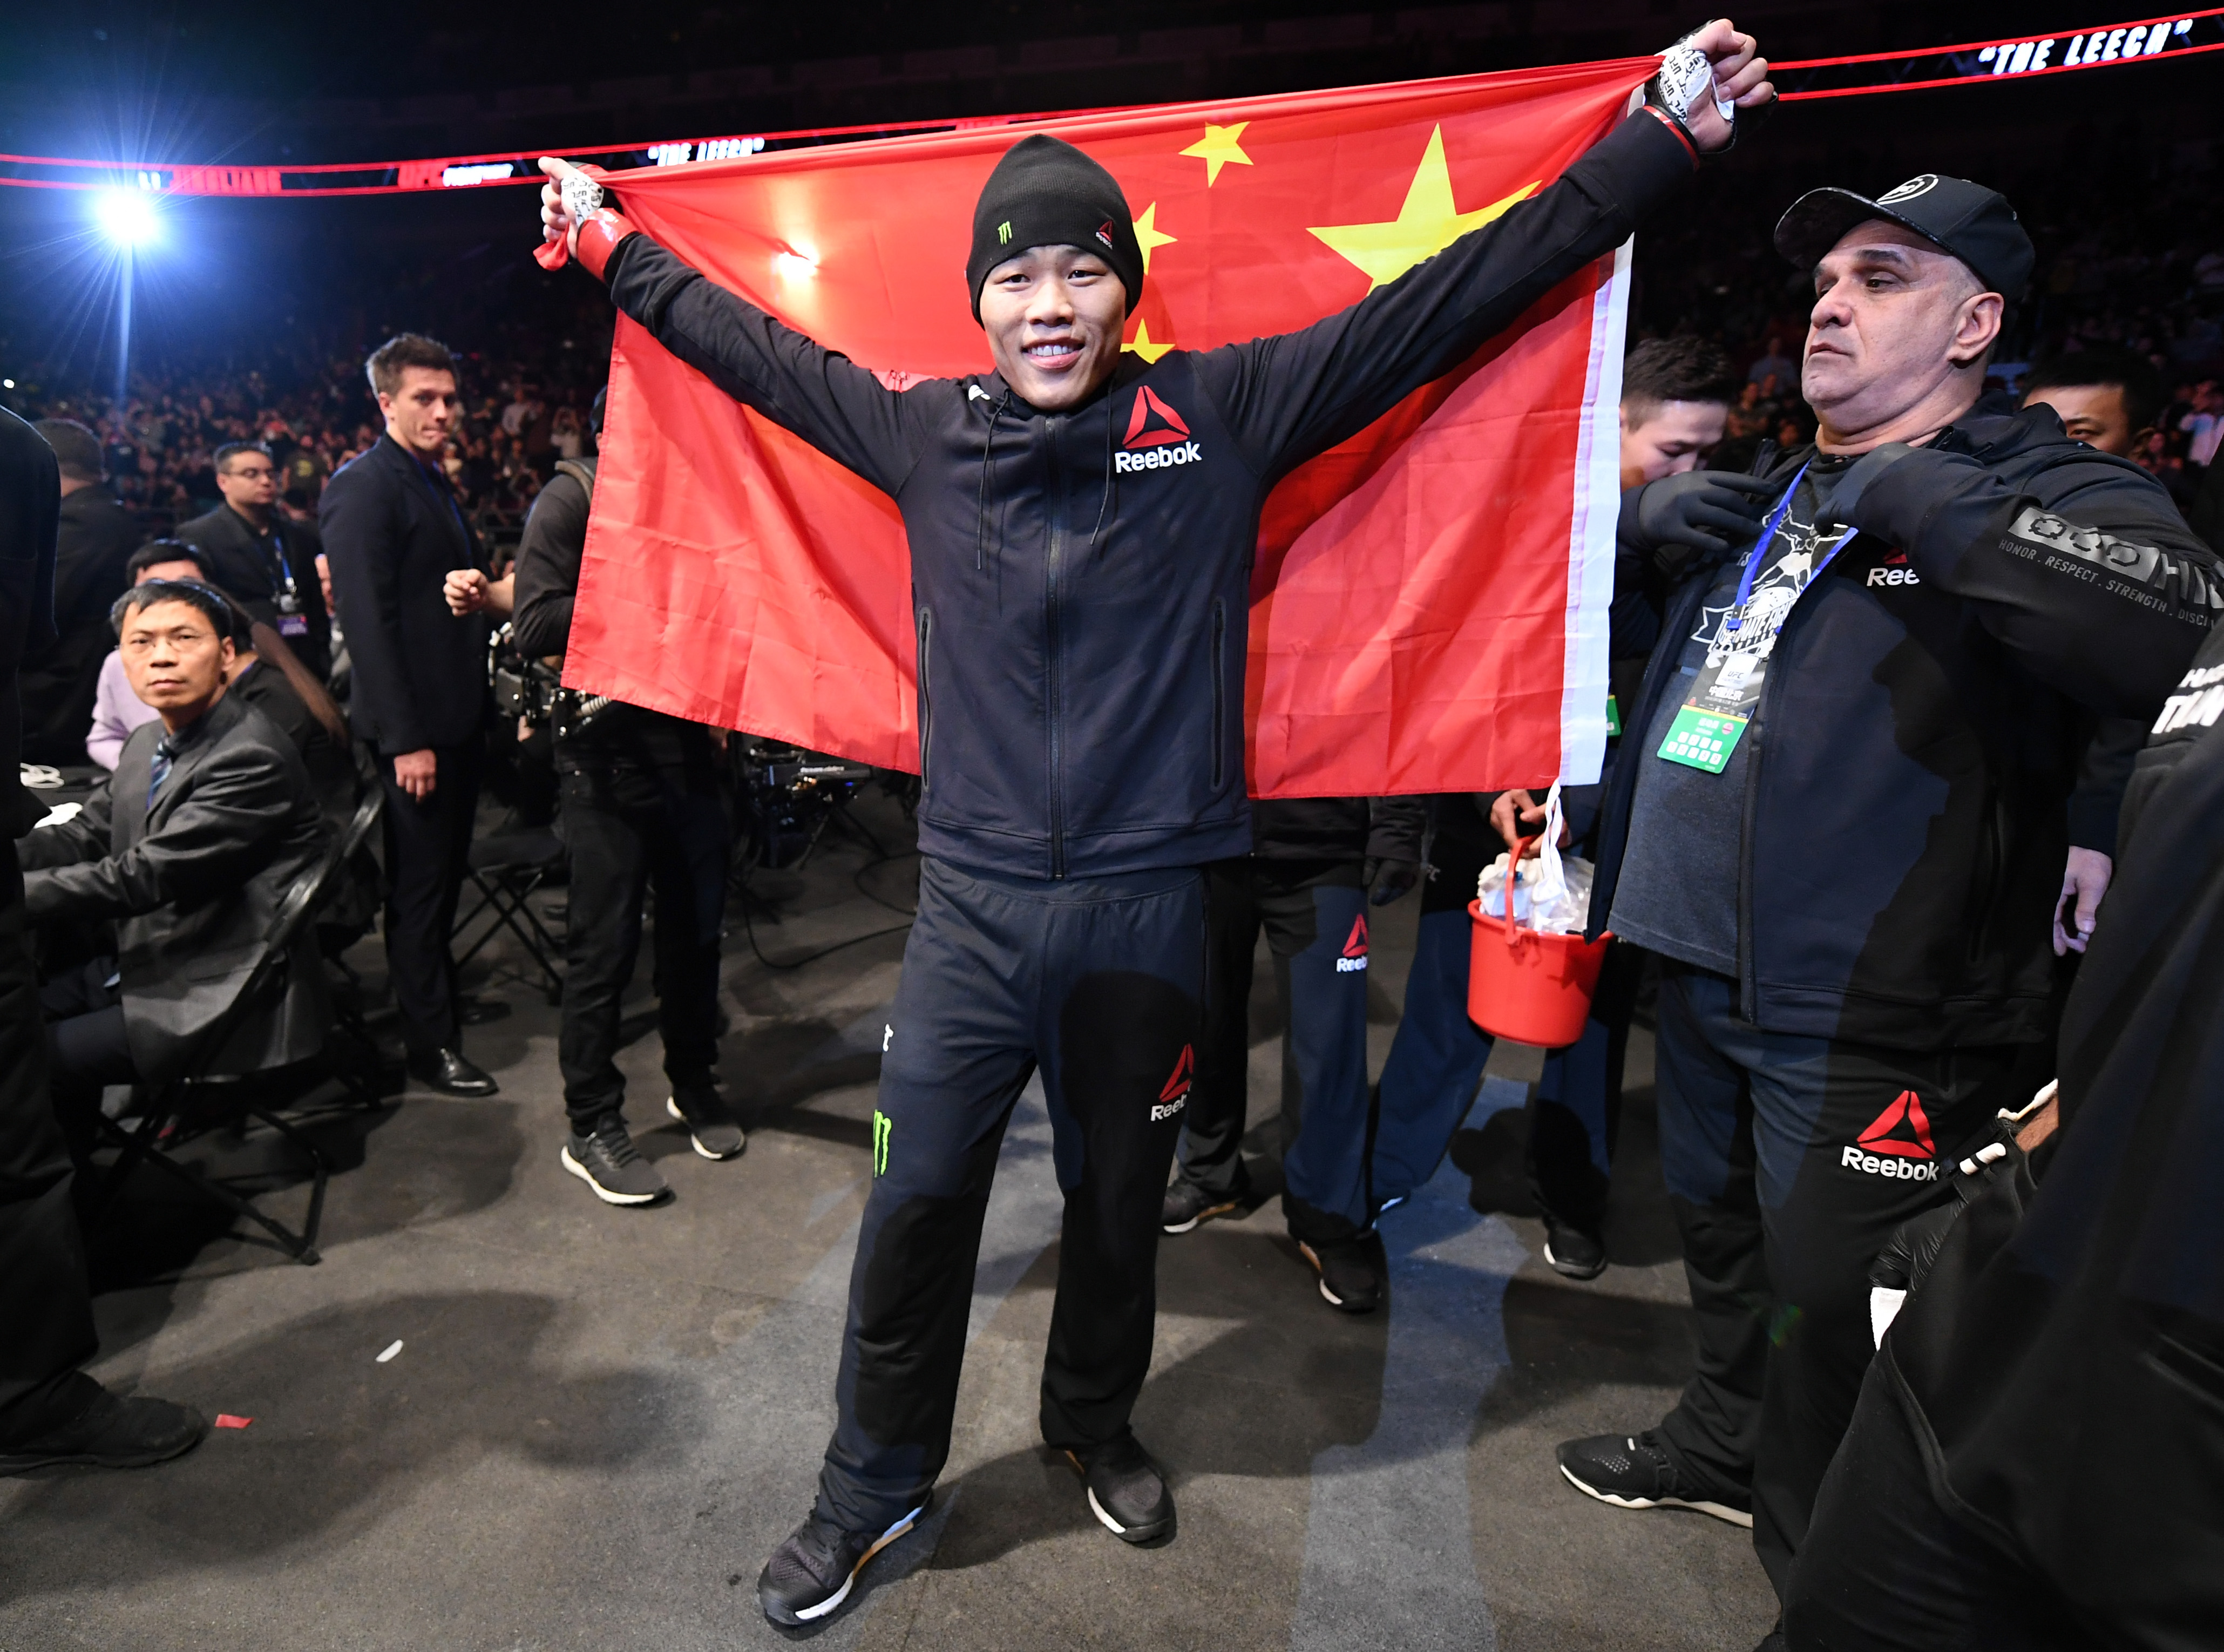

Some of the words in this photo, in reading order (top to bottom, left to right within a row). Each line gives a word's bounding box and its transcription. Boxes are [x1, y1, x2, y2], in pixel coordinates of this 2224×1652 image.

[1114, 441, 1202, 473] Reebok
[1866, 567, 1920, 586] Ree
[1998, 540, 2038, 560] HONOR
[2044, 555, 2099, 583] RESPECT
[2106, 579, 2168, 613] STRENGTH
[1150, 1094, 1188, 1122] Reeb
[1841, 1145, 1940, 1181] Reebok
